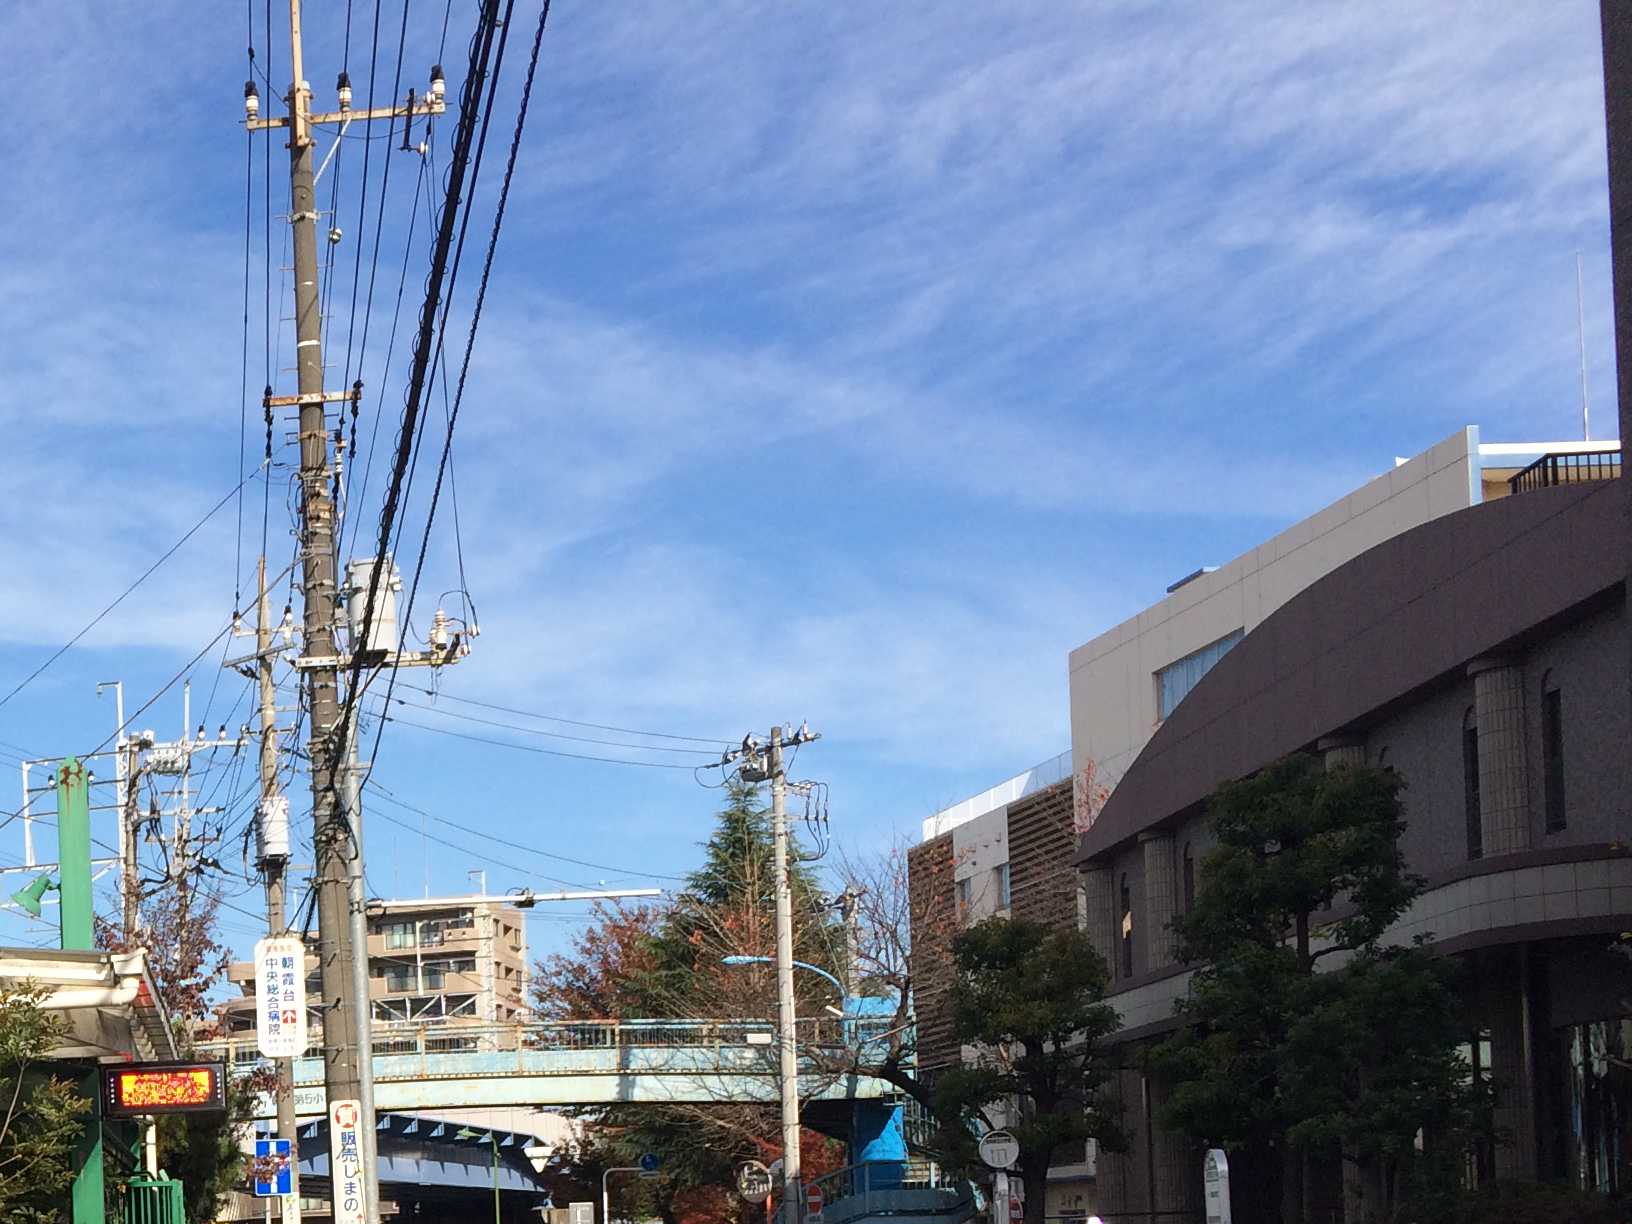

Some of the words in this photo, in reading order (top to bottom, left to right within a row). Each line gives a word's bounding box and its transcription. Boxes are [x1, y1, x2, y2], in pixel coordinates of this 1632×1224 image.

[265, 957, 280, 1035] 中央総合病院
[281, 957, 295, 1002] 朝霞台
